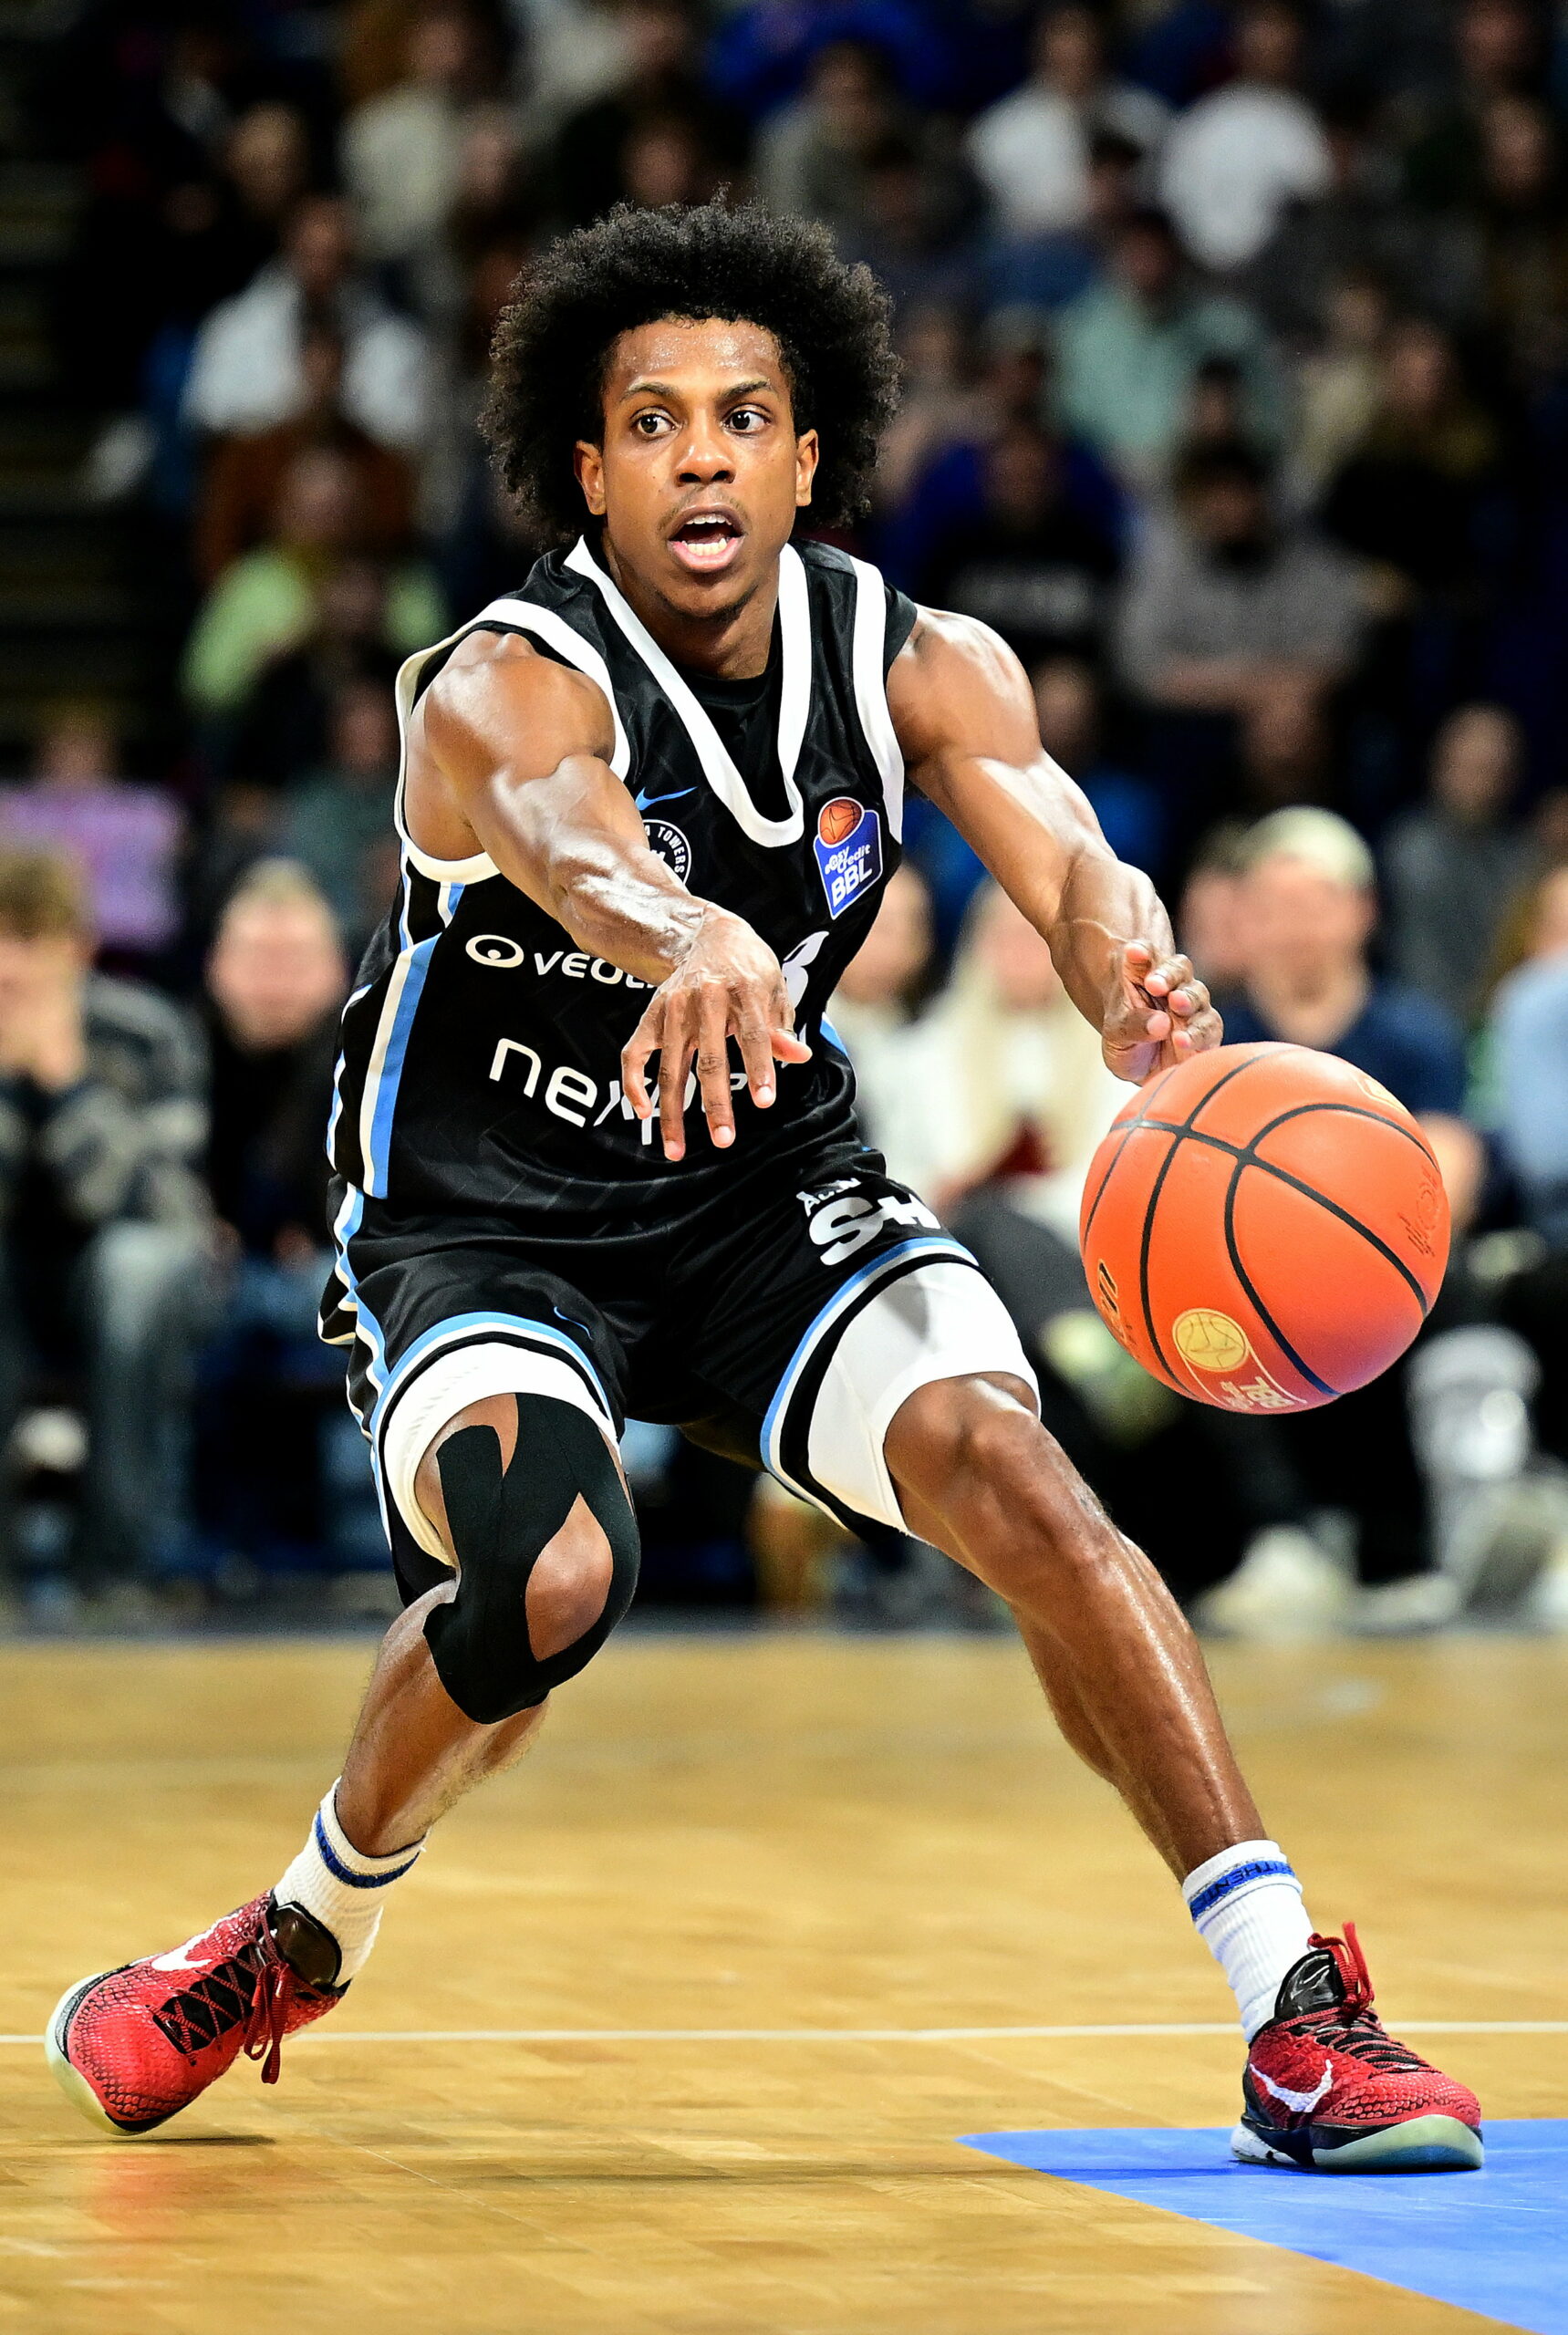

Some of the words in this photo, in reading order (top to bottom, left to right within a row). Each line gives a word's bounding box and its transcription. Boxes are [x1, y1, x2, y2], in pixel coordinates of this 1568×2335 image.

[658, 825, 687, 873] TOWERS
[831, 857, 873, 908] BBL
[534, 950, 657, 989] VEOL
